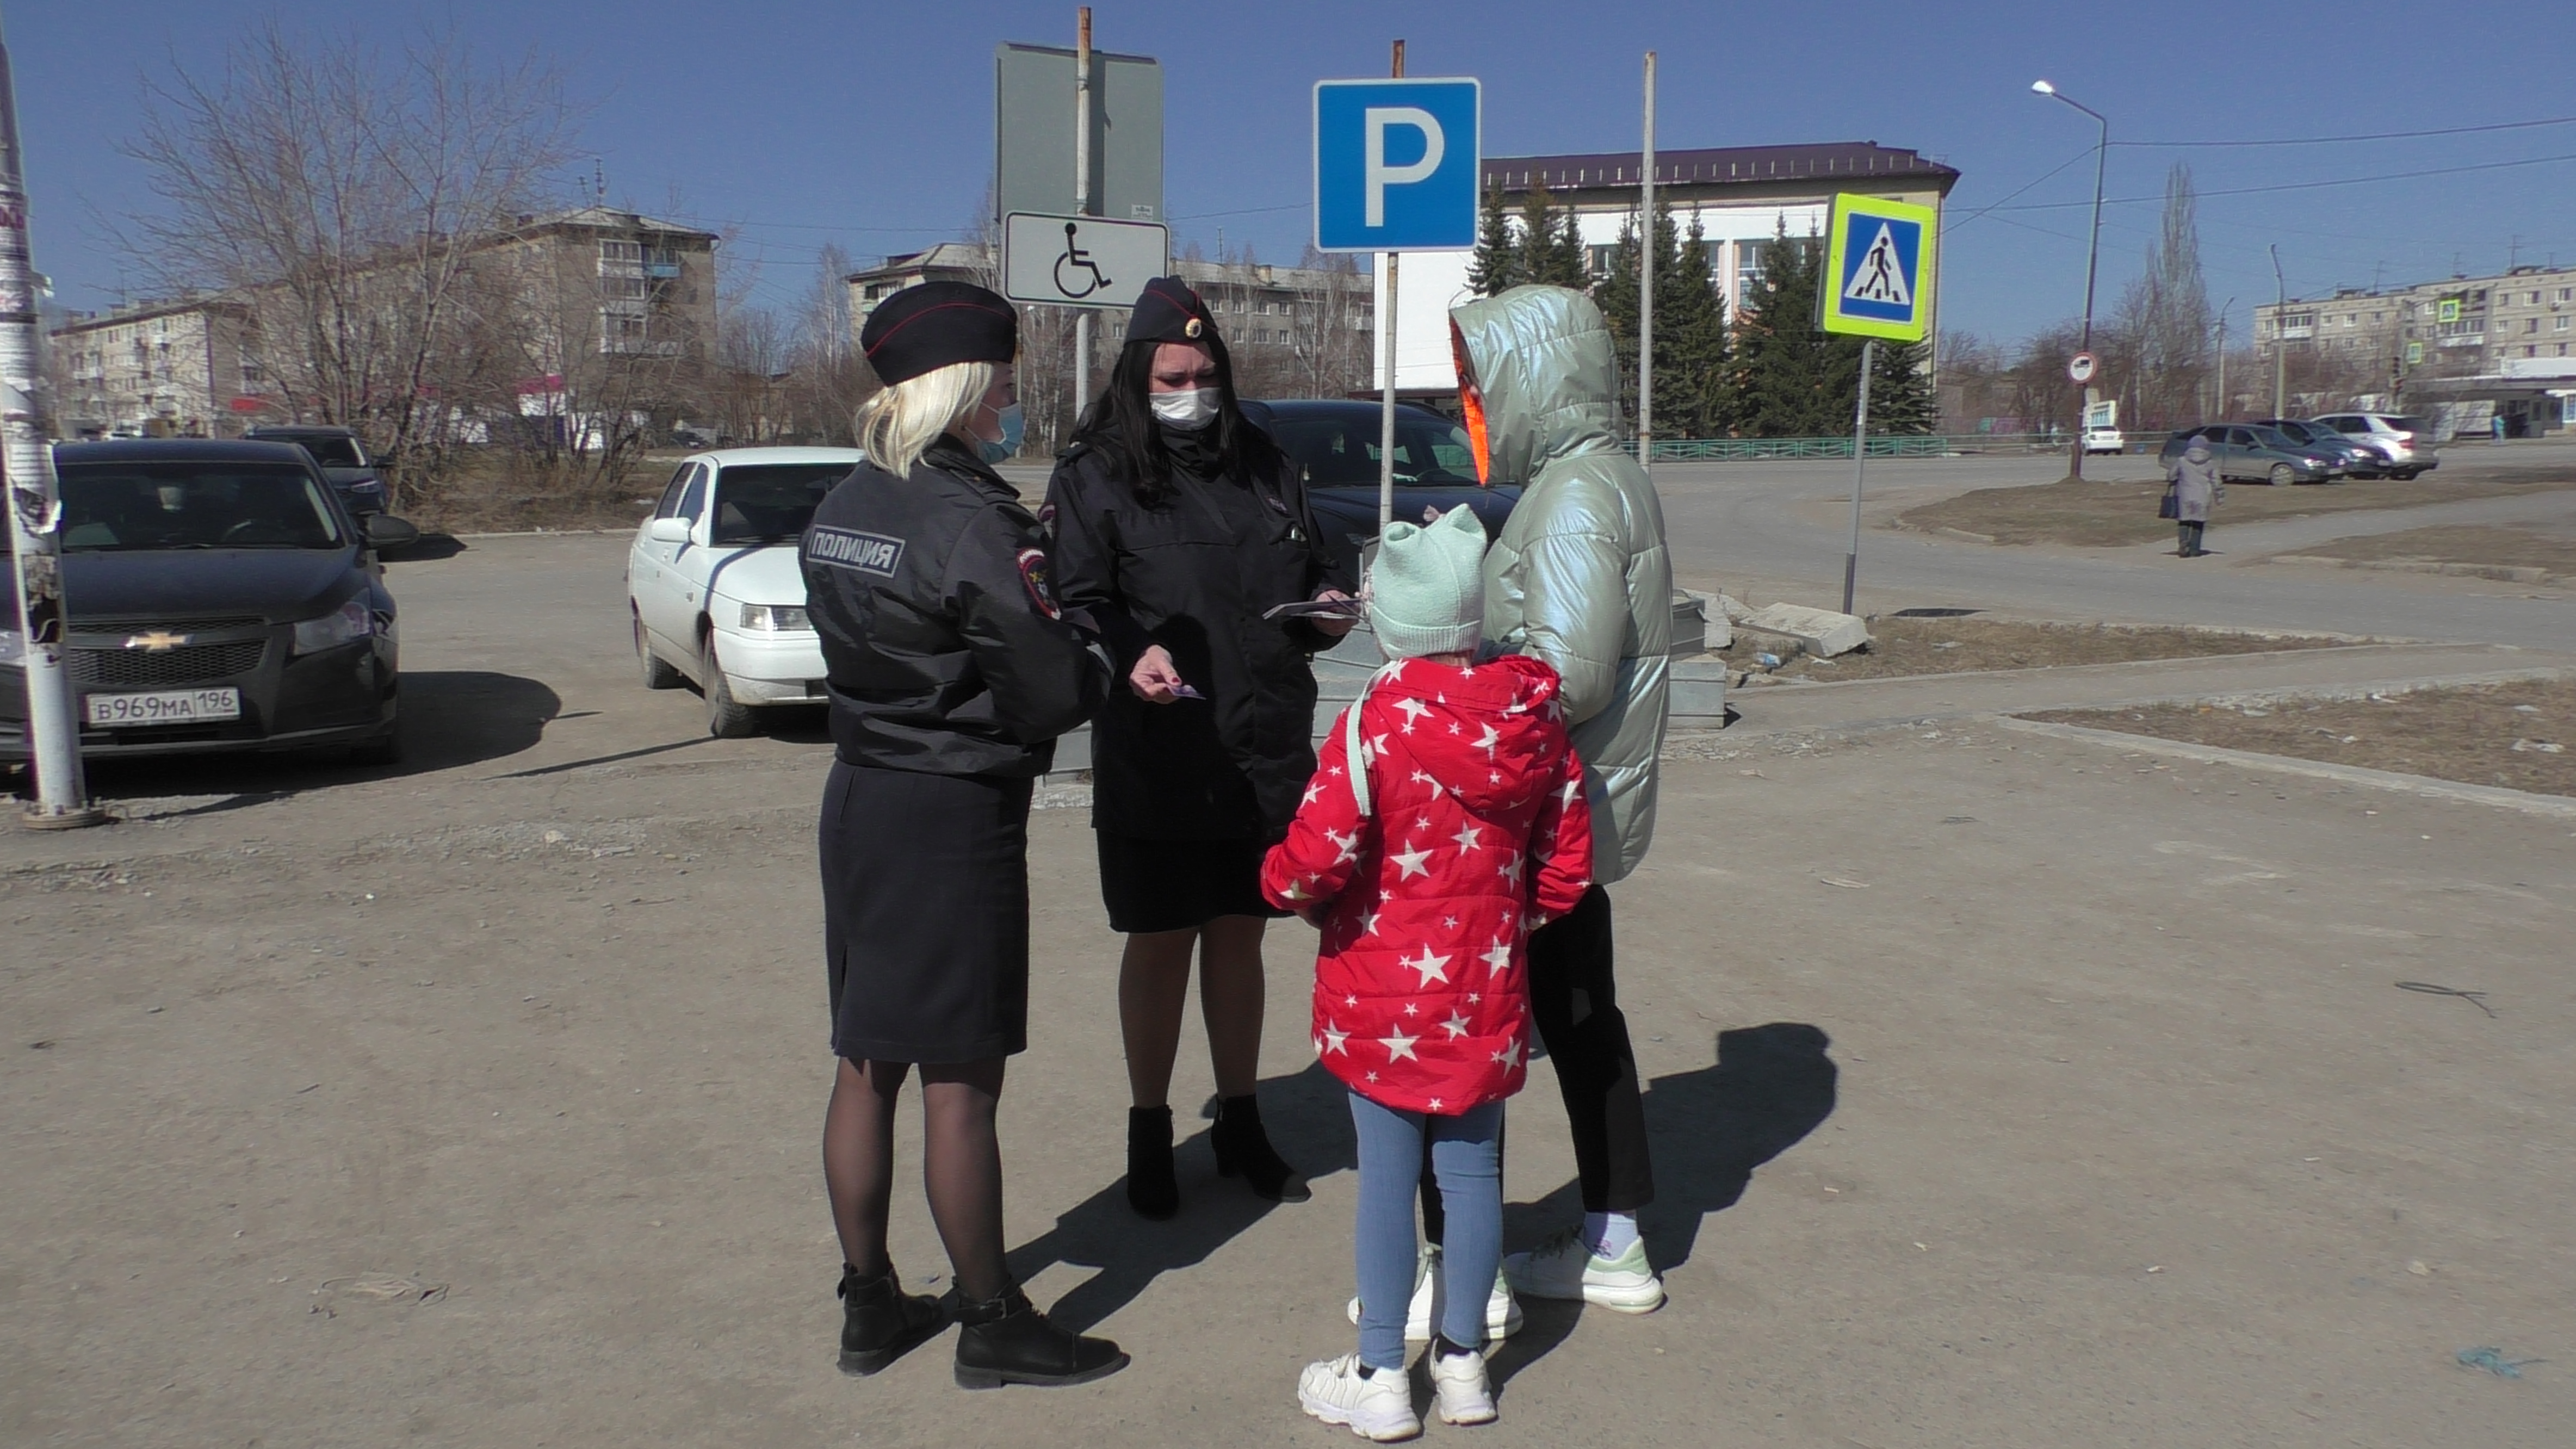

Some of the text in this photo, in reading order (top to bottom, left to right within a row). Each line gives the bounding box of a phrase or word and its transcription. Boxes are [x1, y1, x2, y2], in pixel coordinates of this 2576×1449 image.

[1365, 108, 1445, 227] P
[811, 531, 896, 569] ПОЛИЦИЯ
[197, 691, 233, 708] 196
